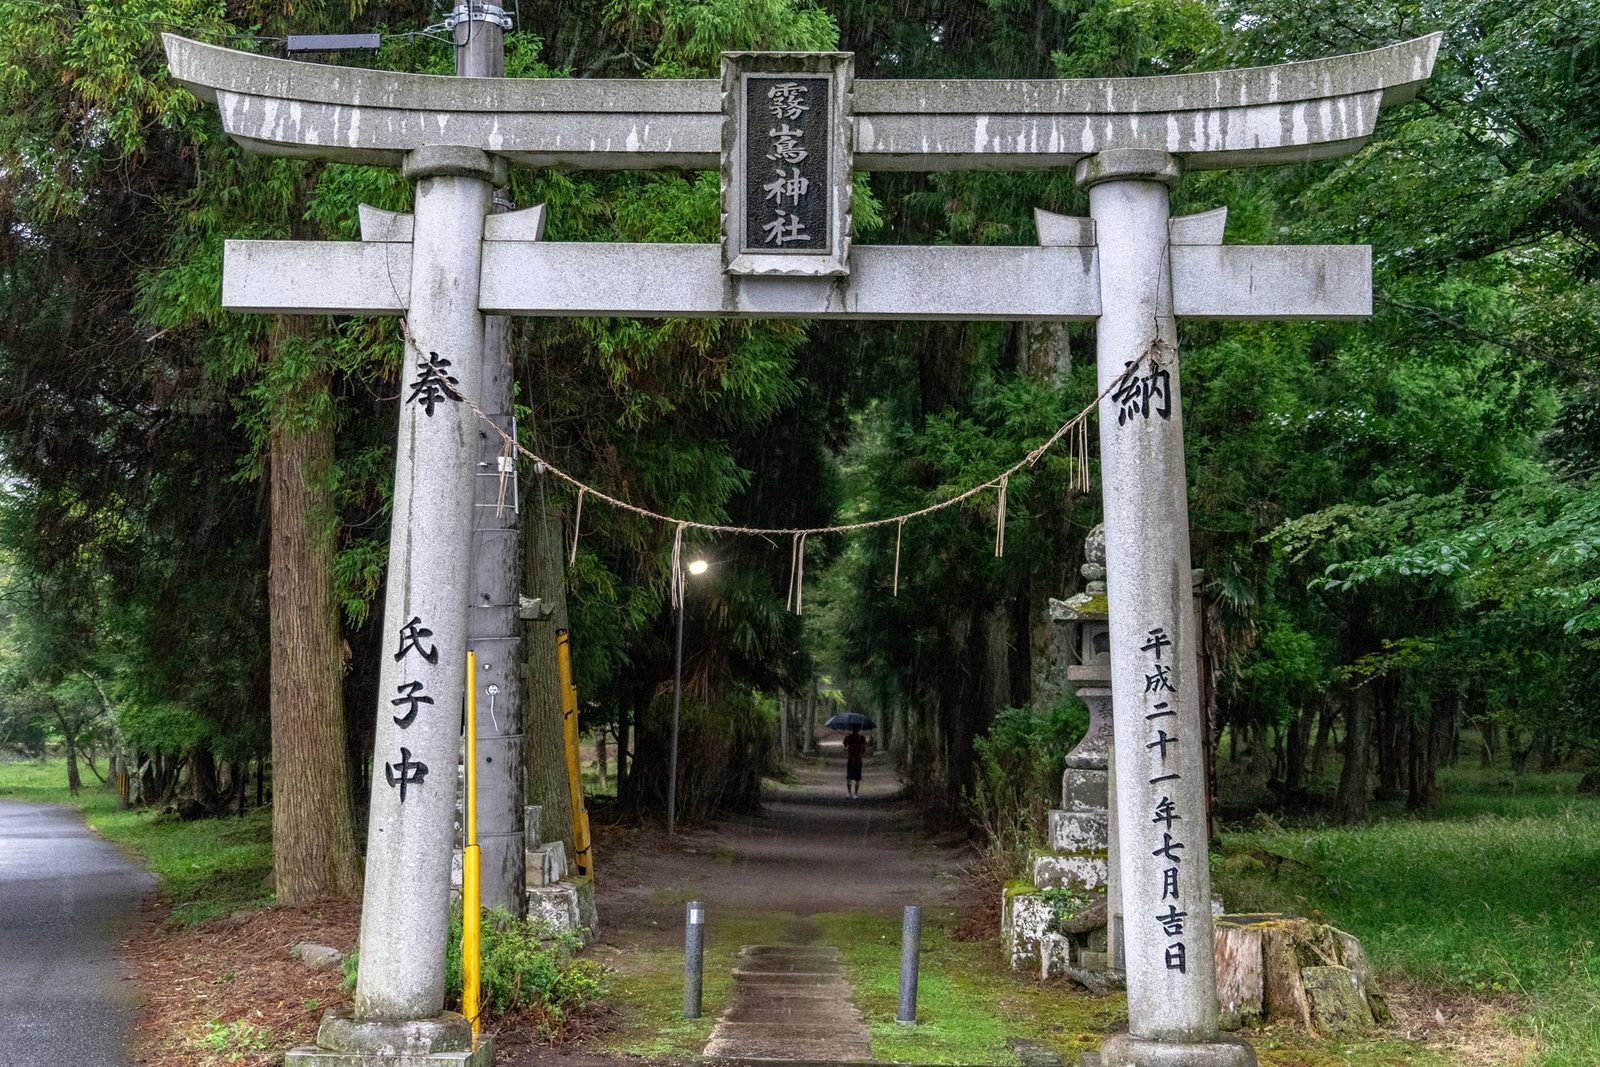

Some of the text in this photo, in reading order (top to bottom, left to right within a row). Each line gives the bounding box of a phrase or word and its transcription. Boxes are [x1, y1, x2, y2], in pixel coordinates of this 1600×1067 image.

[406, 352, 463, 417] 奉
[1112, 359, 1172, 427] 納
[385, 617, 439, 803] 氏子中
[1140, 627, 1188, 975] 平成二十一年七月吉日
